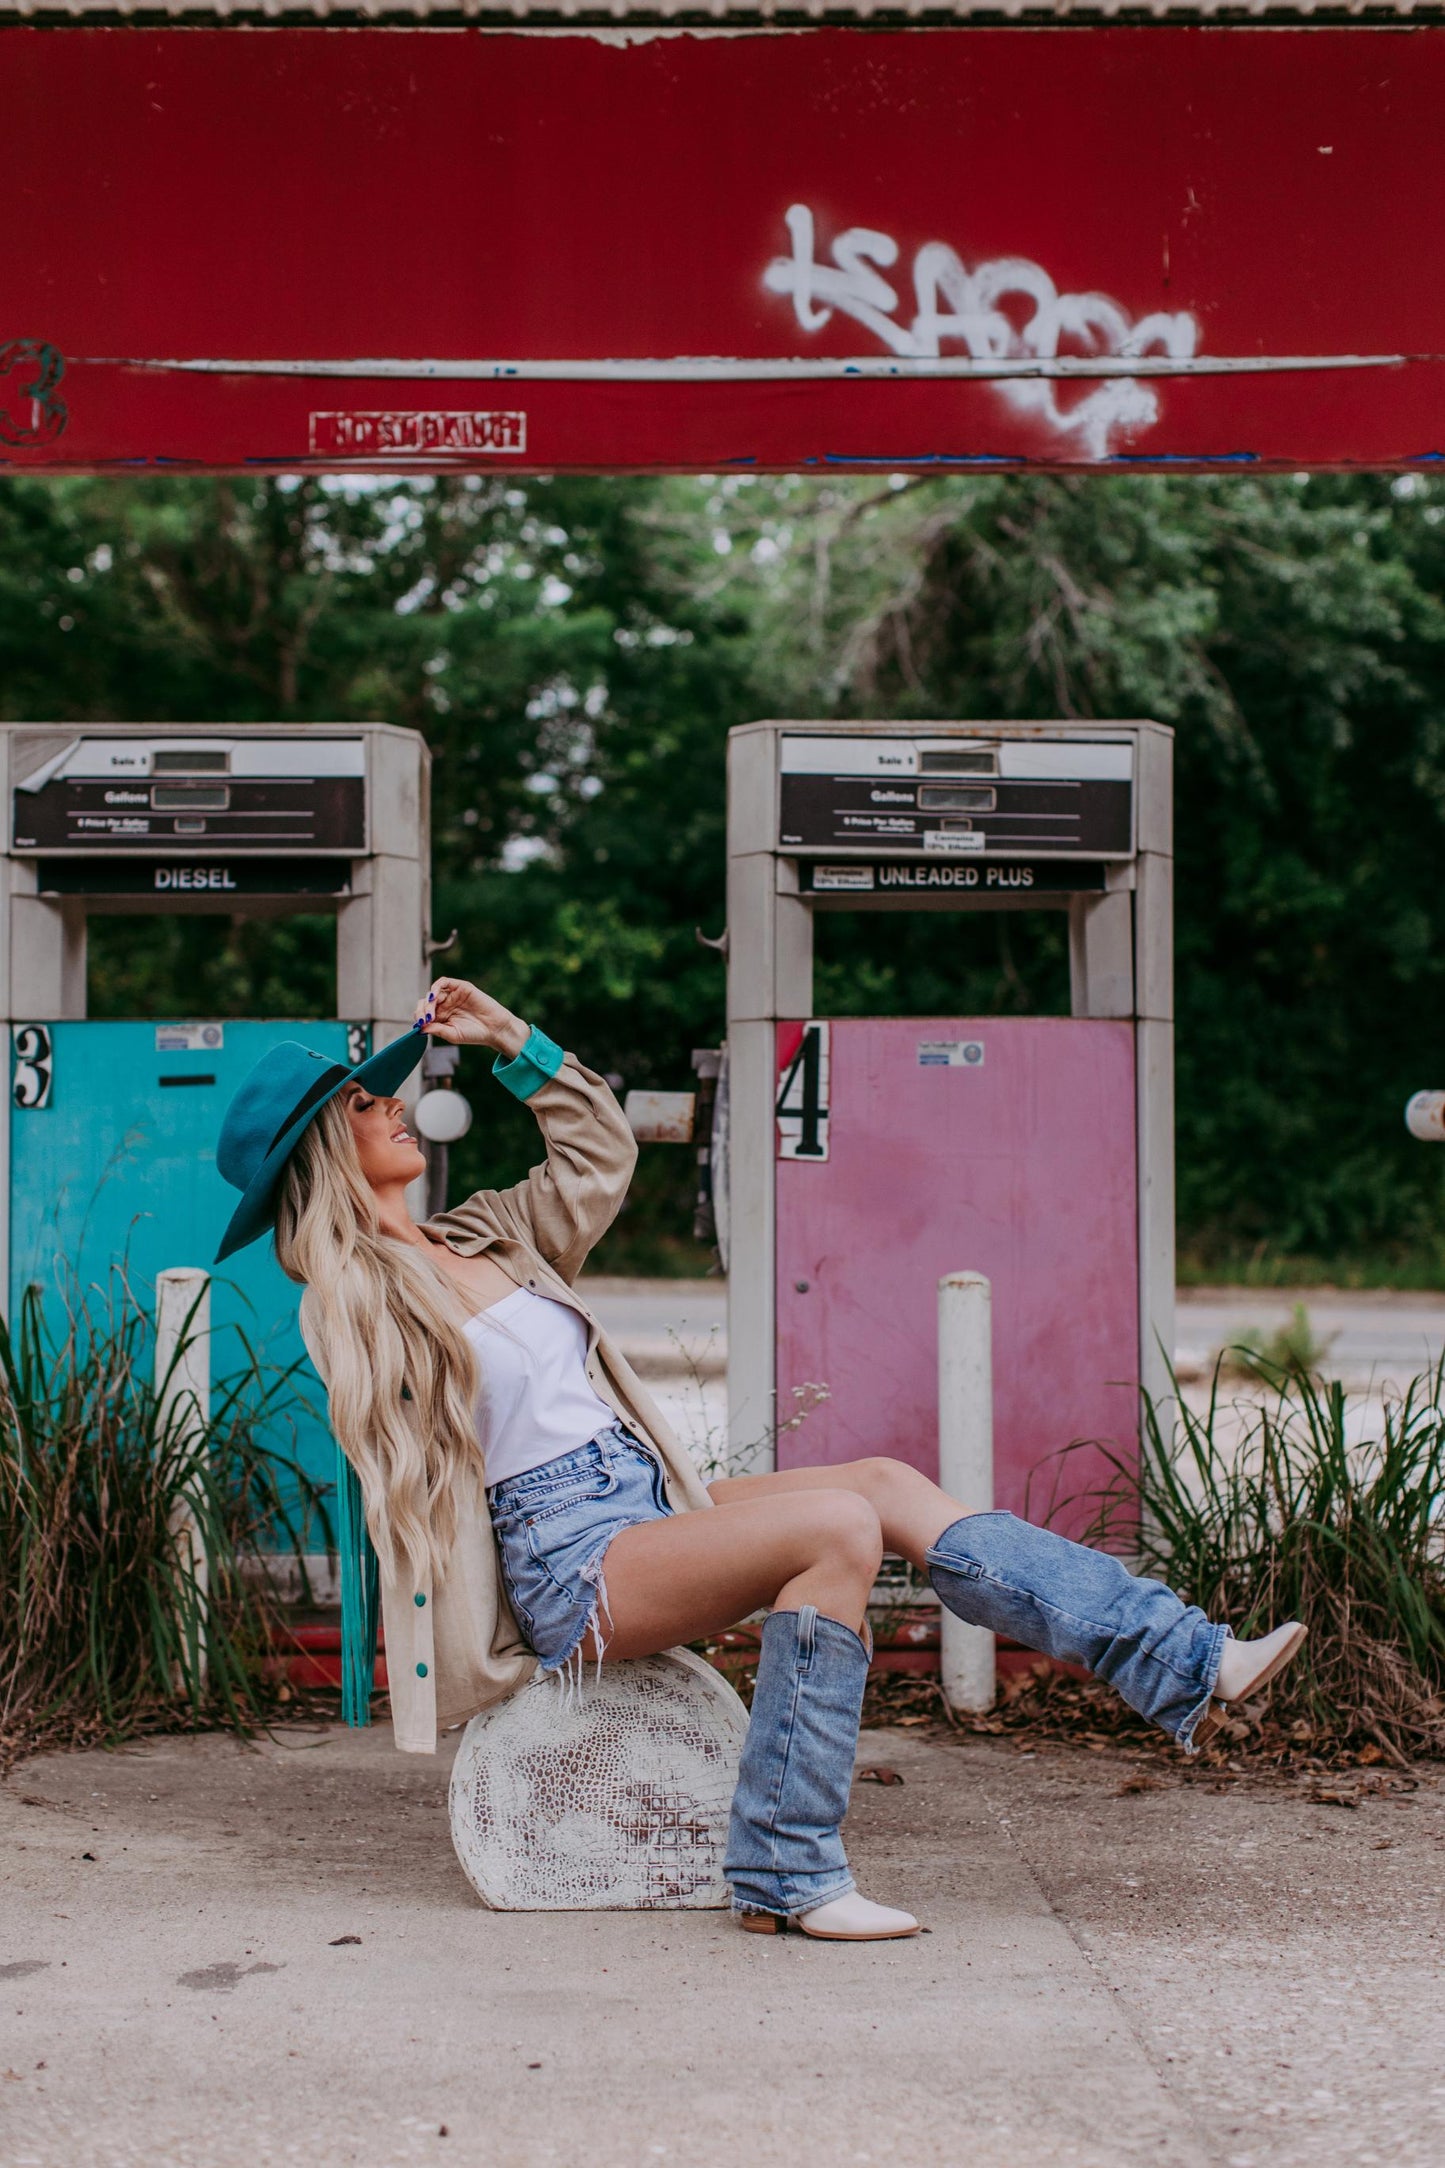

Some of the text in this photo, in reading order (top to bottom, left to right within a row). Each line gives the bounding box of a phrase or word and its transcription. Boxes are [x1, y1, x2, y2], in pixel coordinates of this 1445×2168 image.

[154, 868, 237, 889] DIESEL
[879, 866, 1034, 887] UNLEADED PLUS
[347, 1024, 367, 1065] 3
[14, 1026, 50, 1108] 3
[775, 1027, 829, 1156] 4
